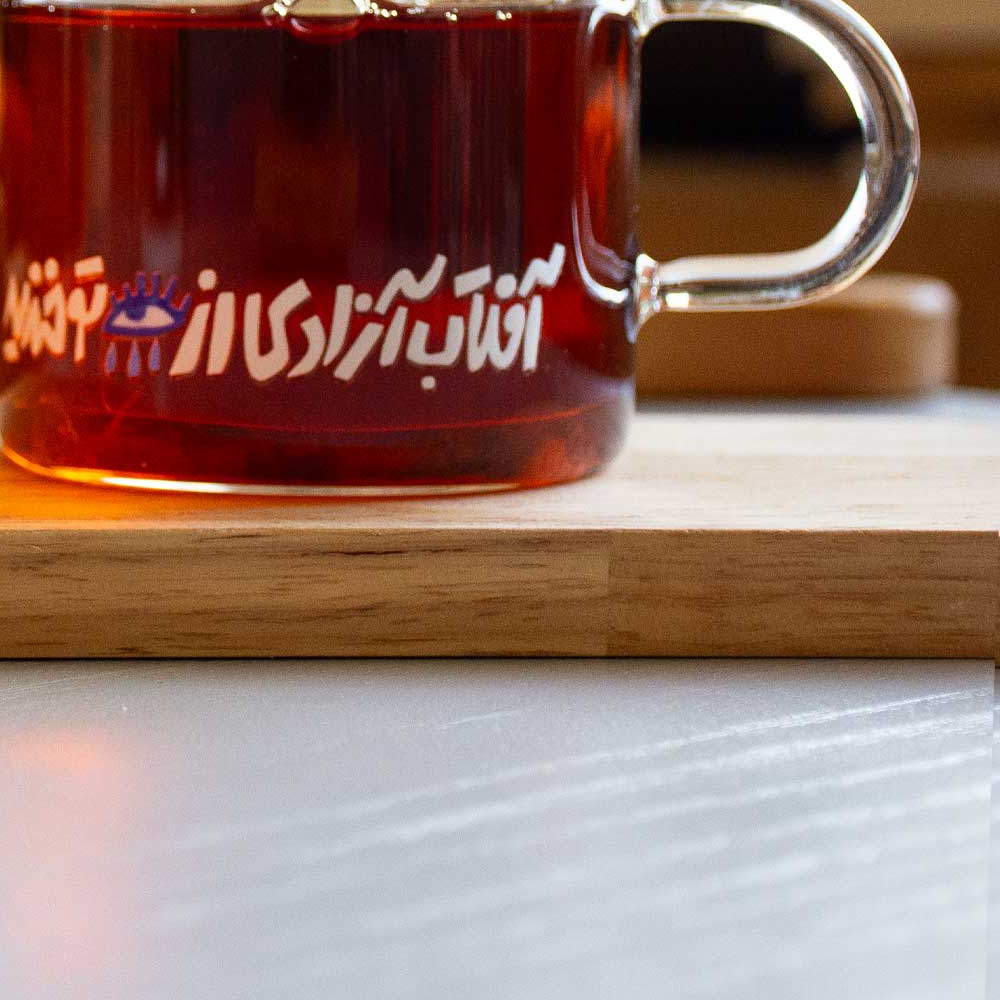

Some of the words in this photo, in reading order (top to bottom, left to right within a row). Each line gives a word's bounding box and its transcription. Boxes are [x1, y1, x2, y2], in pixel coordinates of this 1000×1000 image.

[66, 255, 107, 363] تو
[168, 268, 236, 377] از
[243, 253, 448, 382] آزادی
[406, 242, 567, 391] آفتاب
